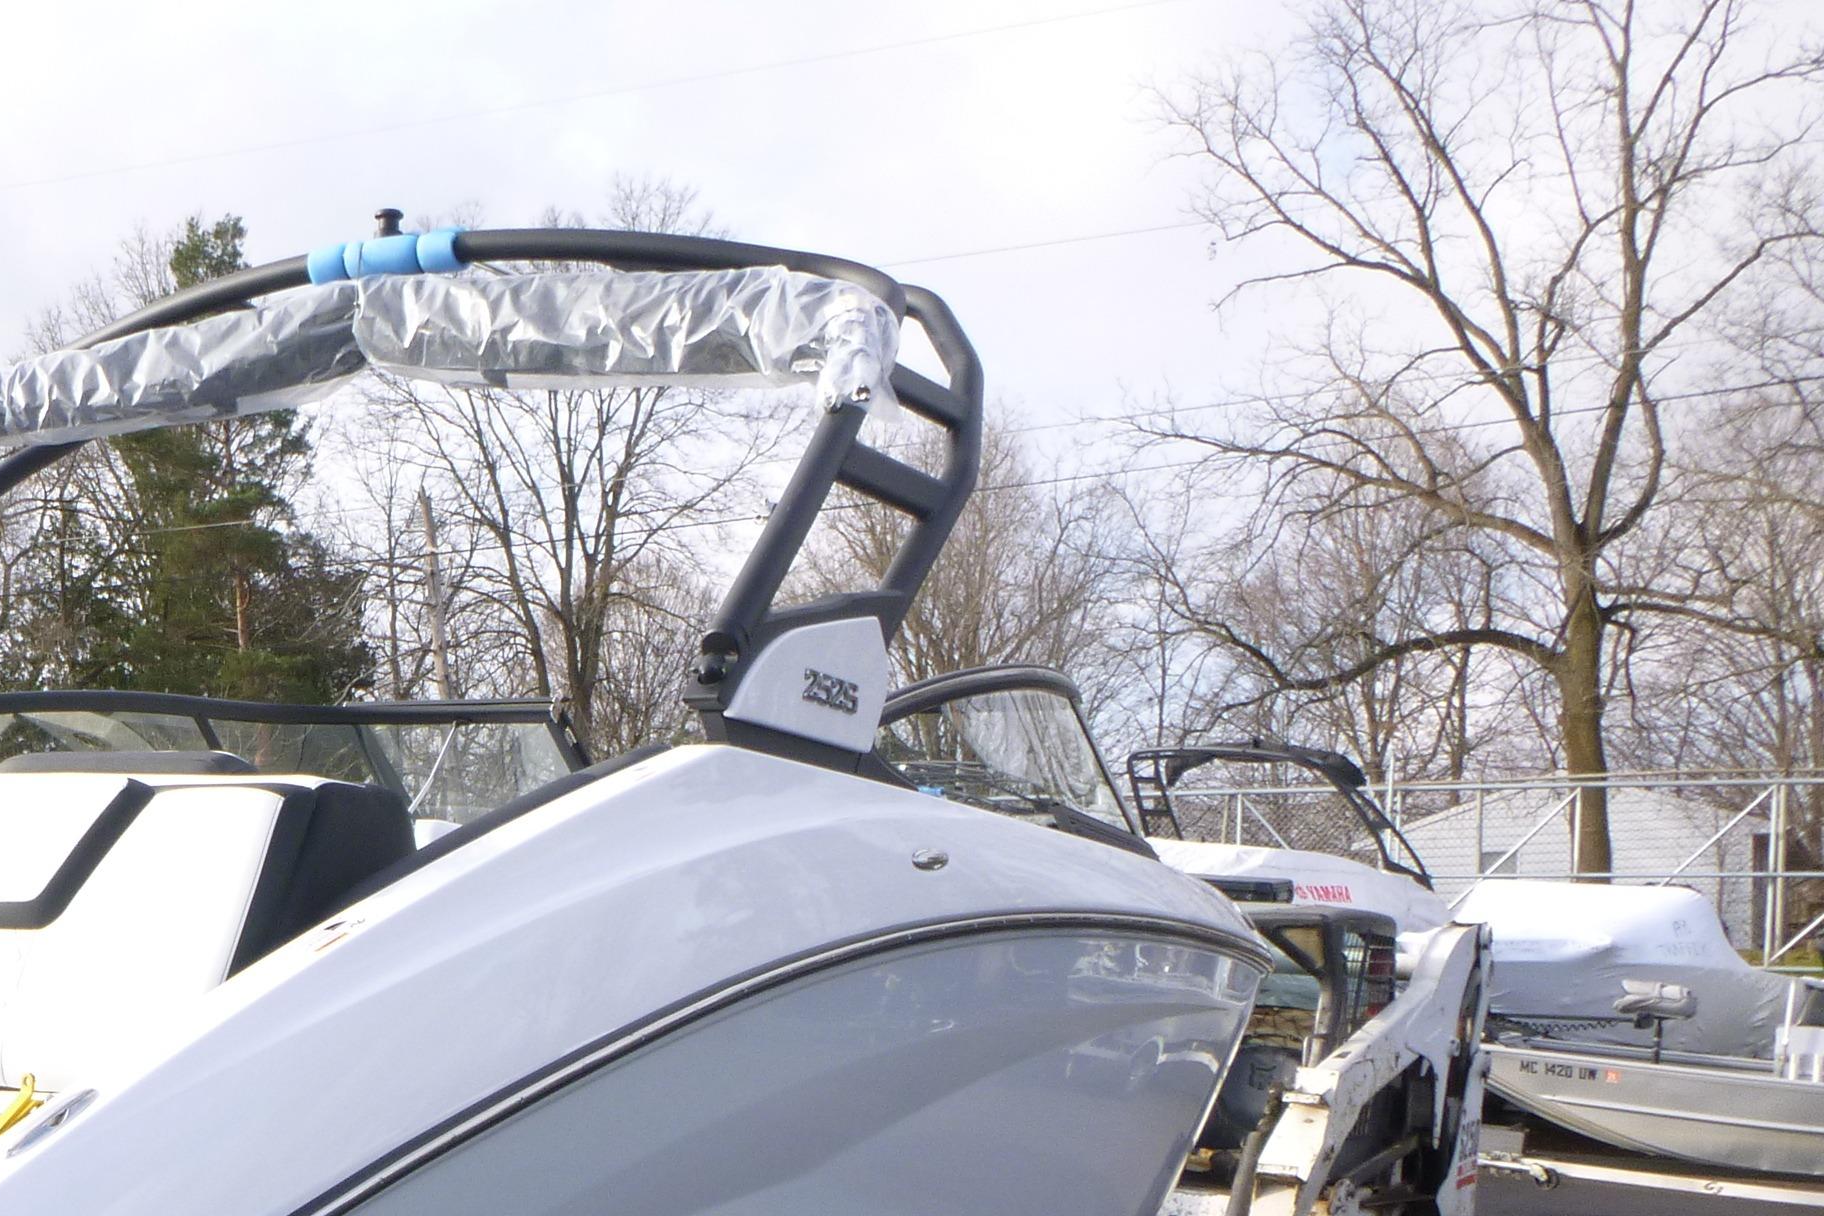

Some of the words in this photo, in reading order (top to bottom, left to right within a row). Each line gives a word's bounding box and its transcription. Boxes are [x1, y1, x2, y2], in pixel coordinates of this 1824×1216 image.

[1306, 885, 1352, 903] YAMAHA
[1519, 1060, 1538, 1074] MC
[1544, 1062, 1573, 1079] 1420
